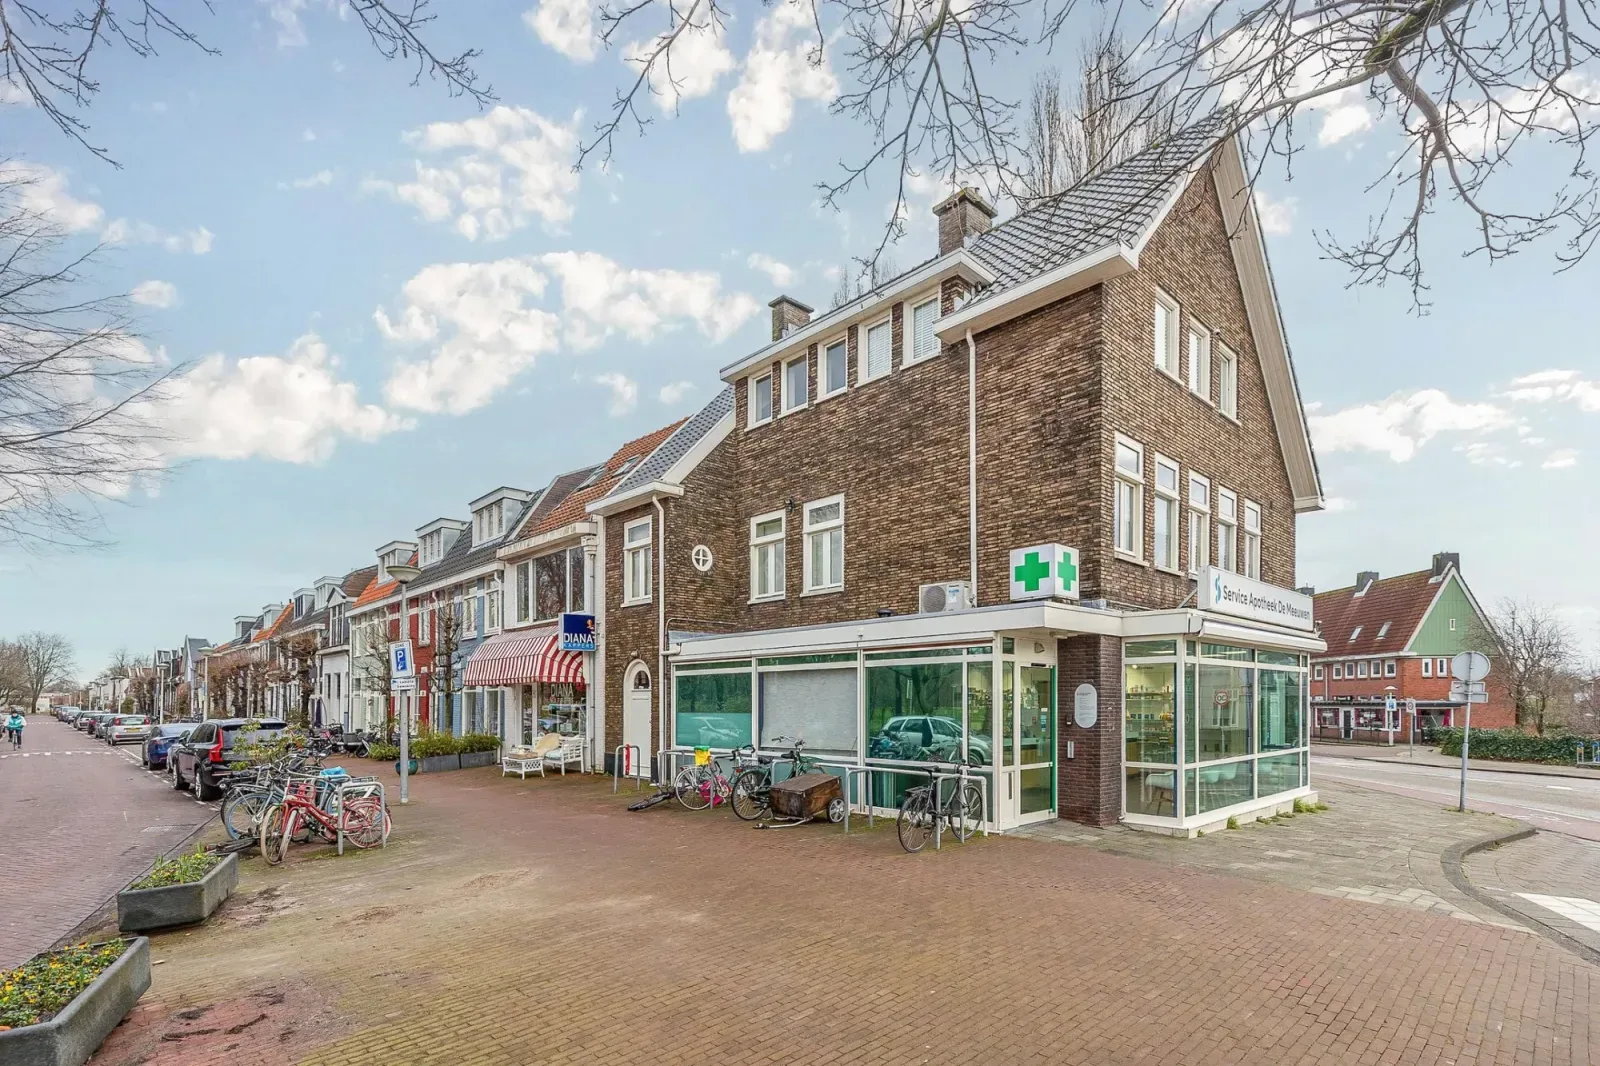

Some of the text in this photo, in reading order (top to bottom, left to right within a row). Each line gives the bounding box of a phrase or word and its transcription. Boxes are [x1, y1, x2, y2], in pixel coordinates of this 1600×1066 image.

[1223, 585, 1310, 620] Service Apotheek De Meeuwen
[563, 632, 593, 643] DIANA
[397, 650, 404, 662] P
[551, 682, 574, 697] DIANA
